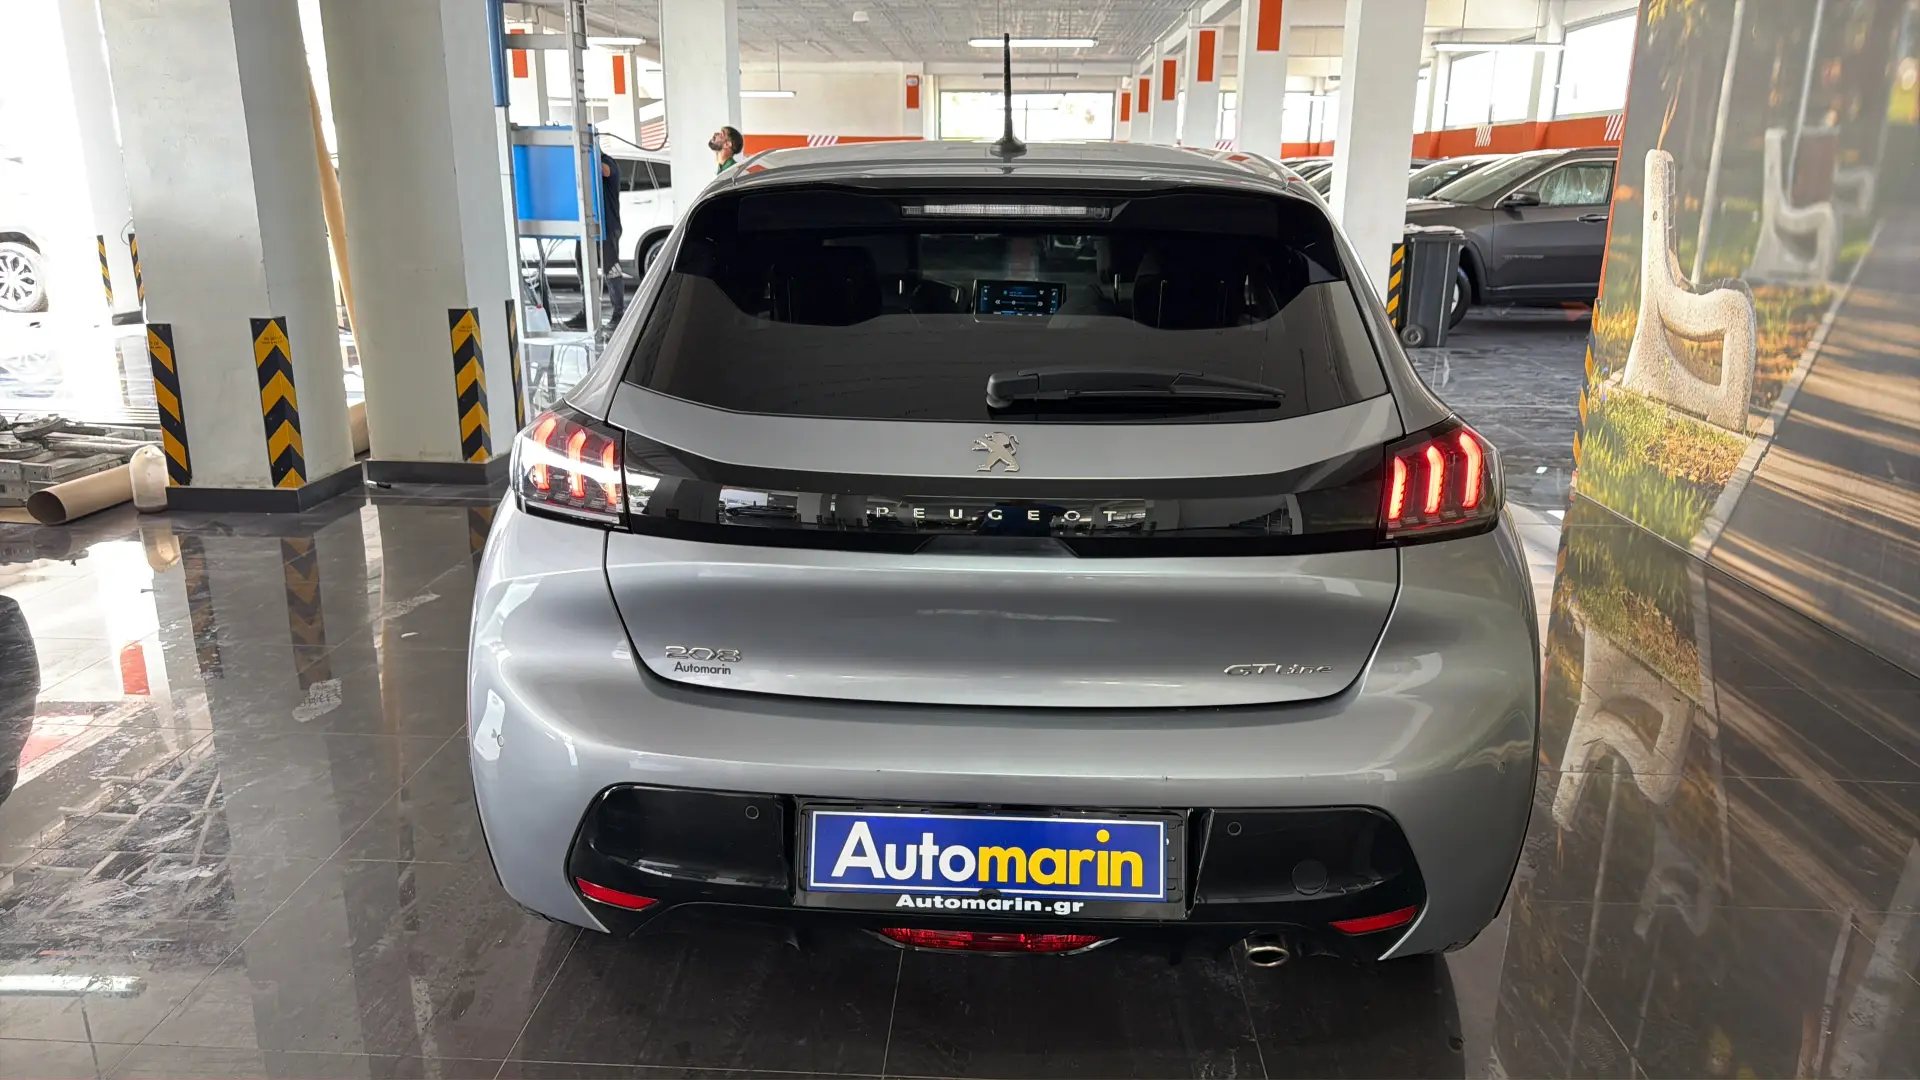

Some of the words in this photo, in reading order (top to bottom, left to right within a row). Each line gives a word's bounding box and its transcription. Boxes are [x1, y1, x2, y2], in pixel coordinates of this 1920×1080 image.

[876, 506, 1117, 522] PEUGEOT
[665, 645, 742, 662] 208
[674, 661, 732, 675] Automarin
[1223, 663, 1276, 676] GT
[831, 821, 1143, 888] Automarin
[895, 893, 1085, 915] Automarin.gr
